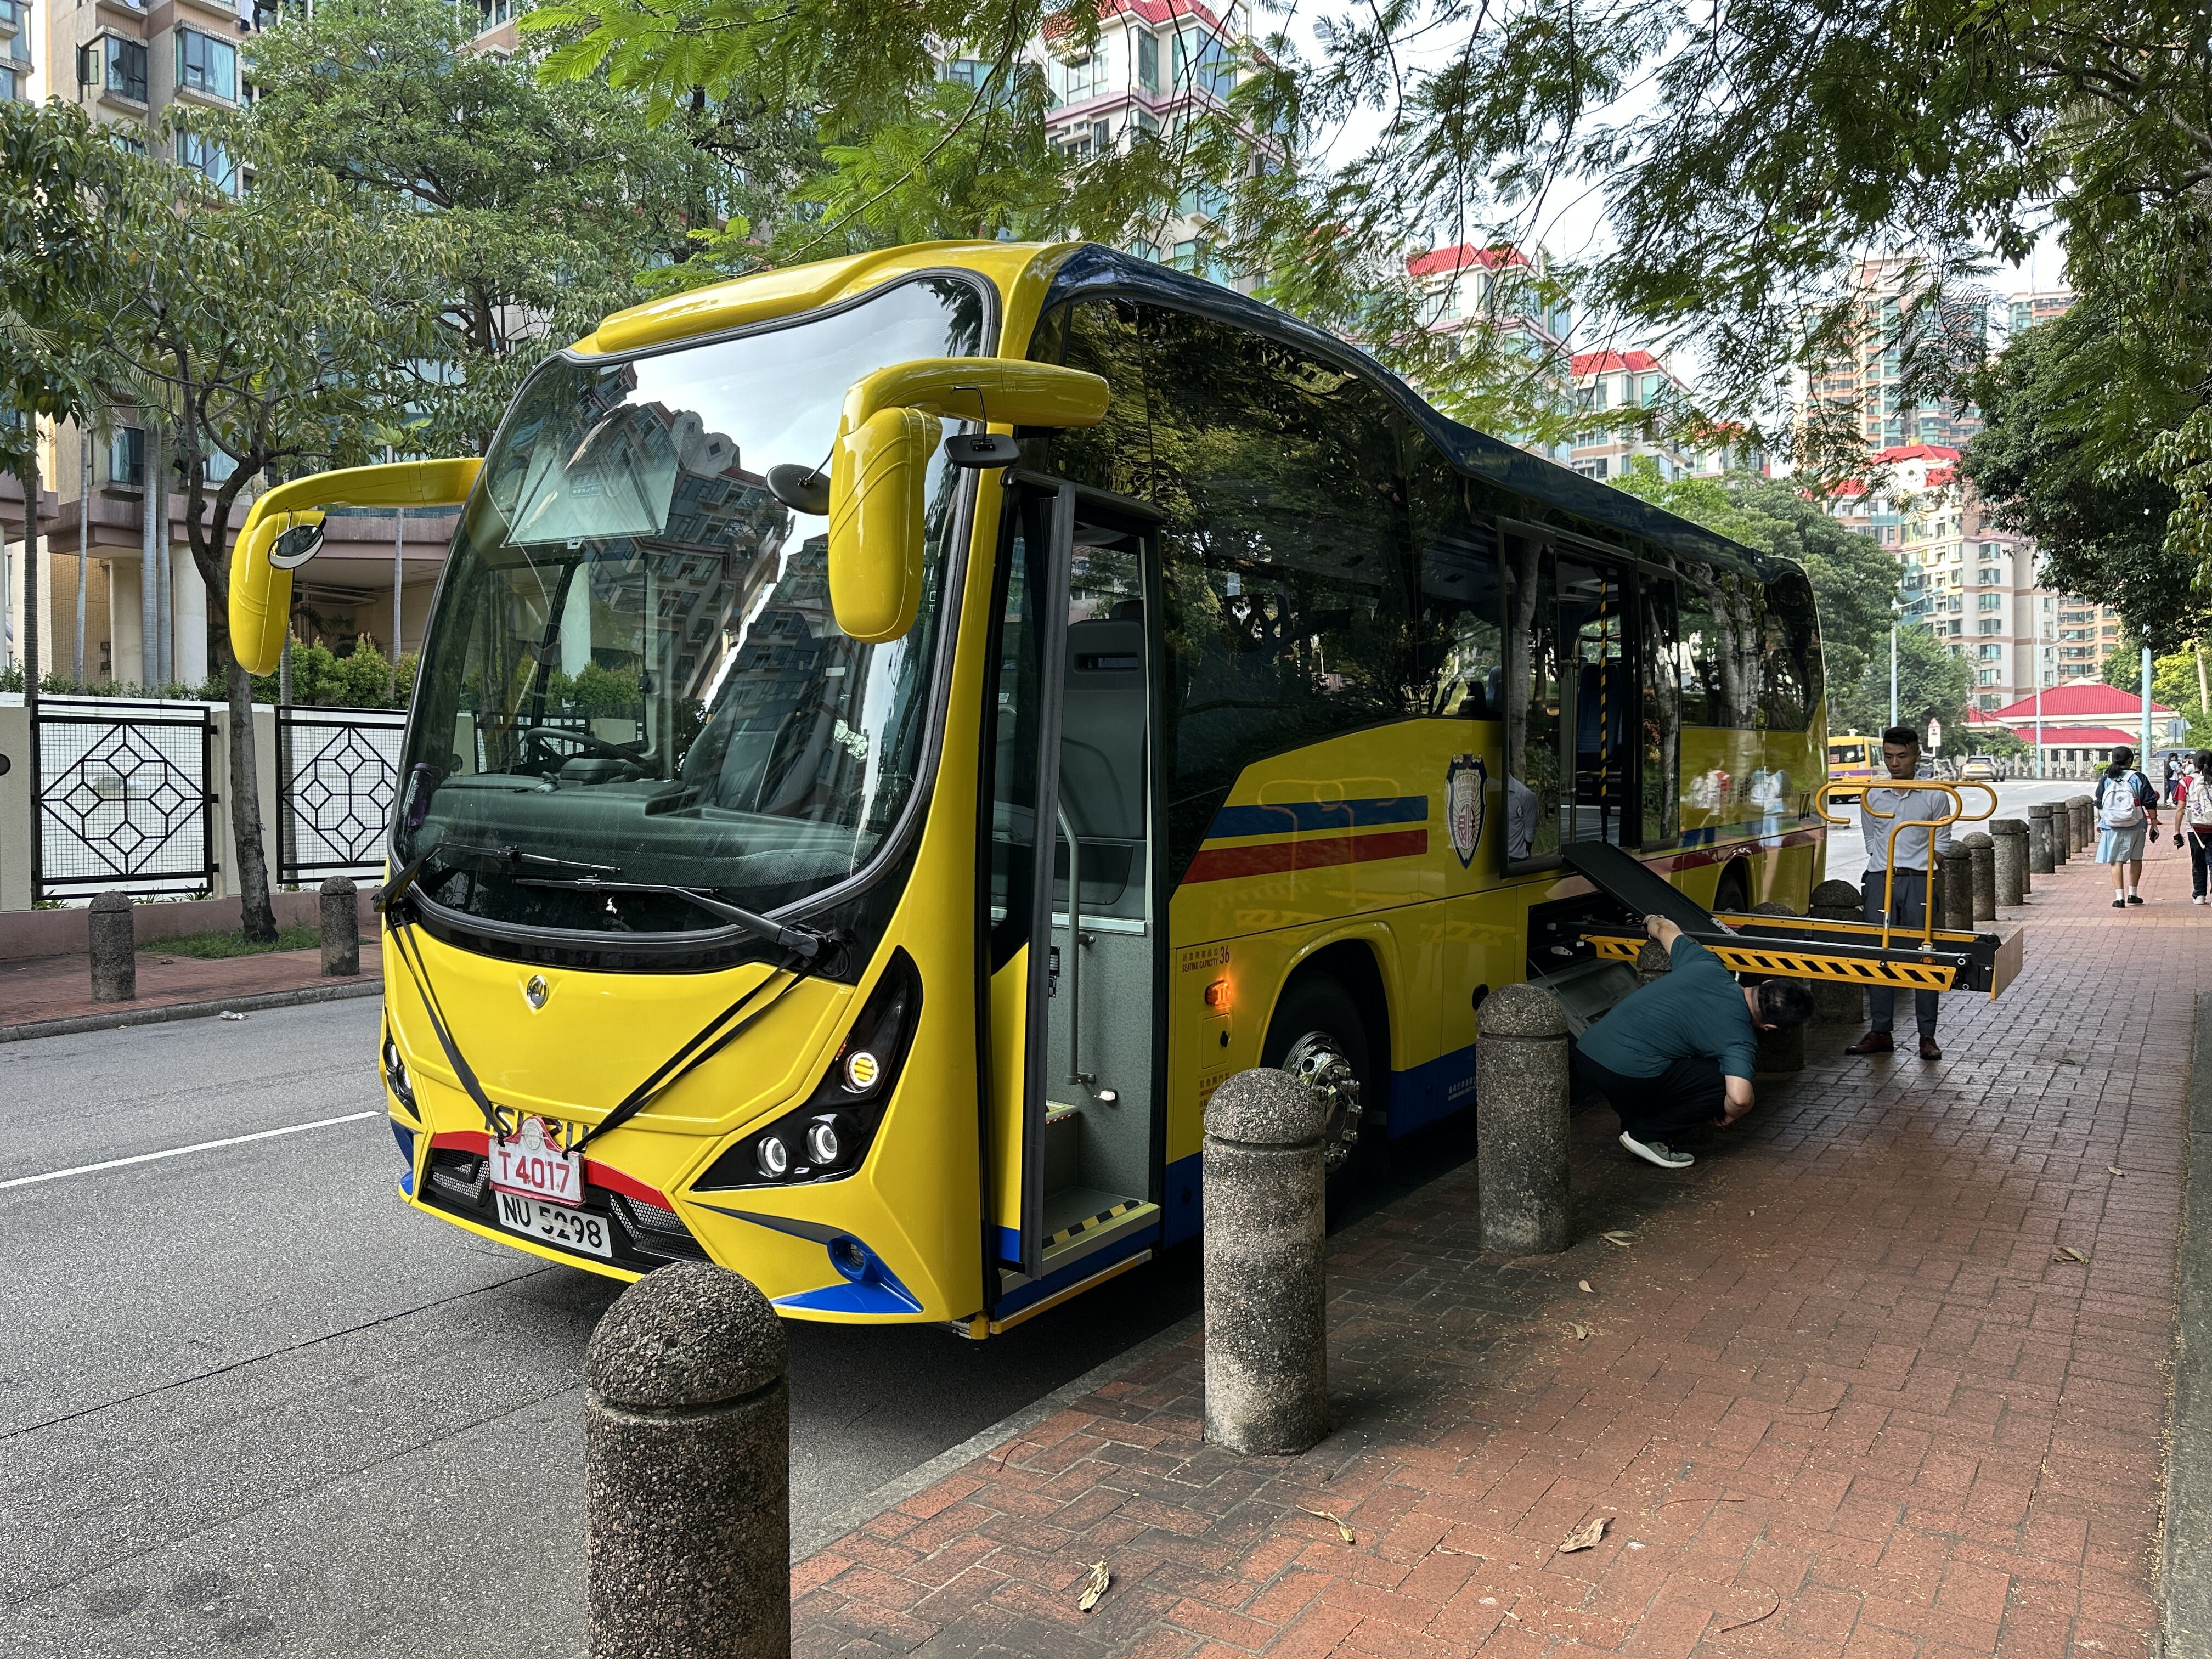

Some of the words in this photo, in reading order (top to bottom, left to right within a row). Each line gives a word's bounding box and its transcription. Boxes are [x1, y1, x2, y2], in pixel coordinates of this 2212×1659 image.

[1220, 945, 1229, 964] 36
[1182, 962, 1198, 972] SEATING
[1199, 957, 1218, 969] CAPACITY
[502, 1194, 531, 1227] NU
[538, 1205, 603, 1248] 5298
